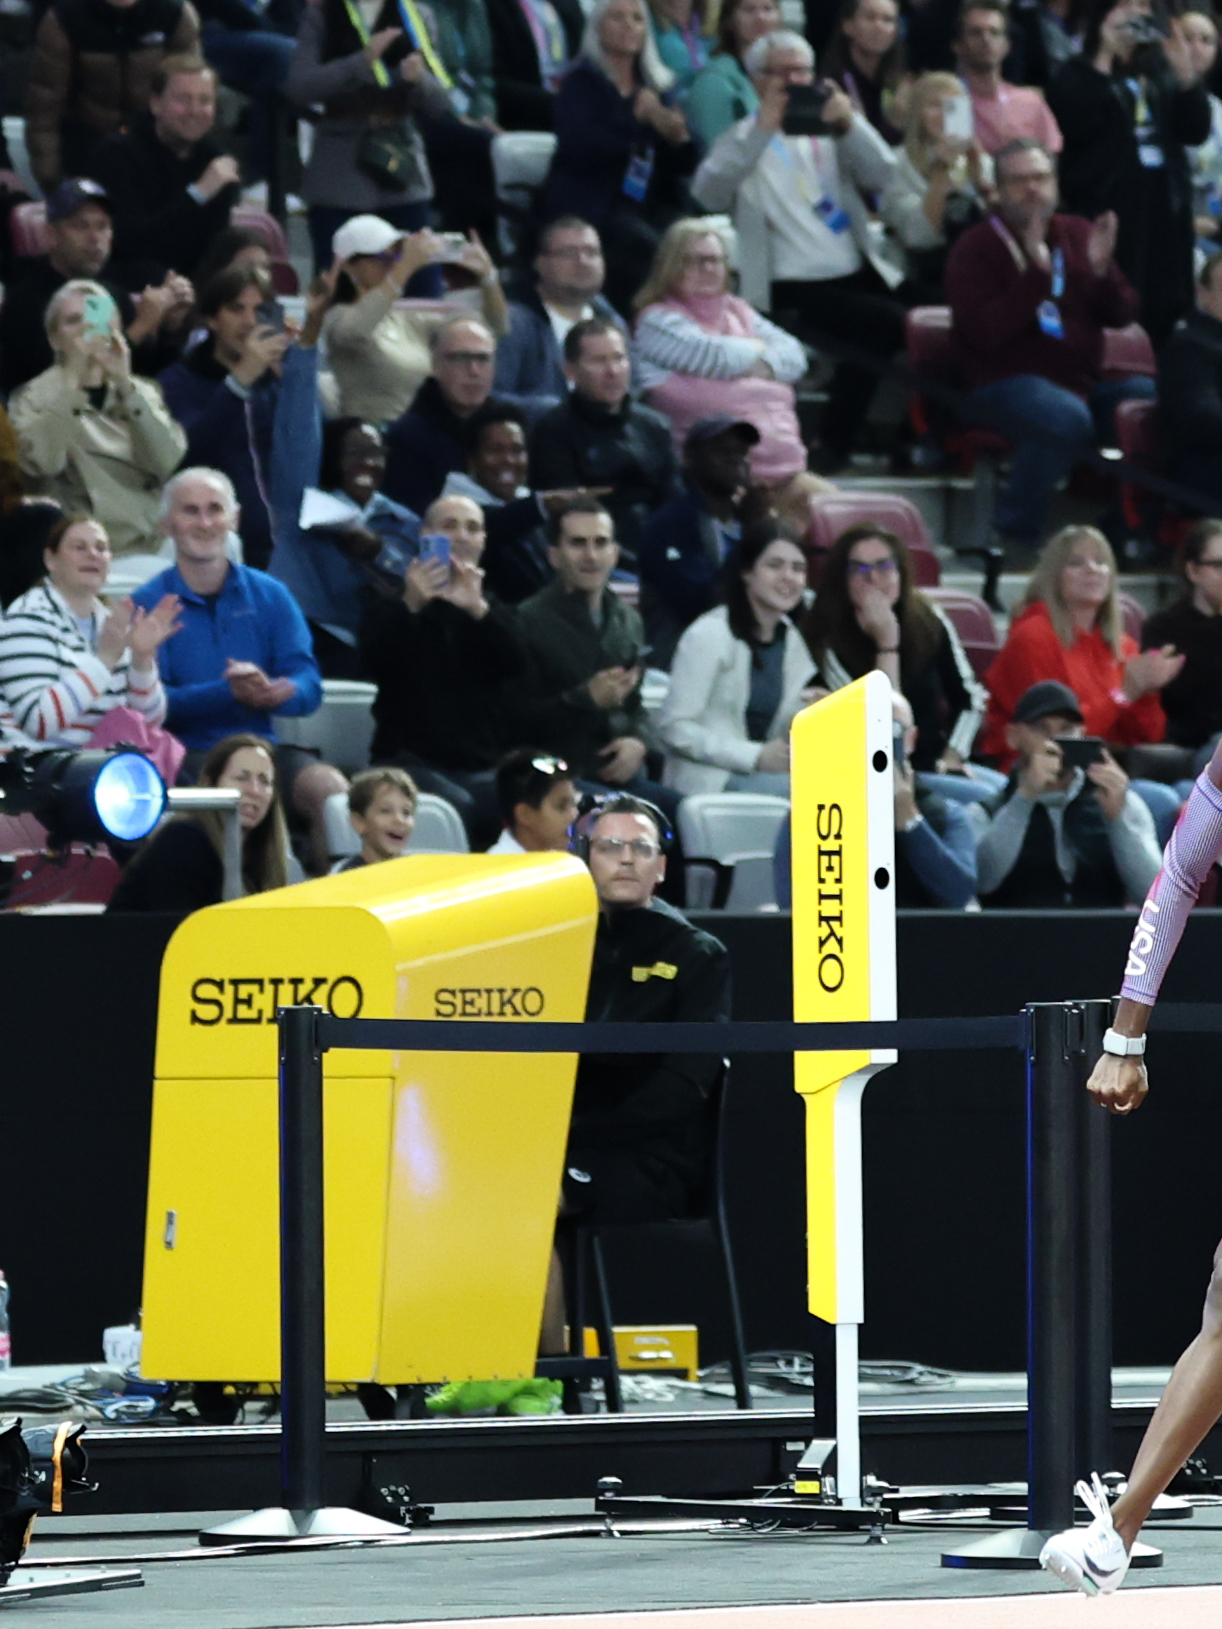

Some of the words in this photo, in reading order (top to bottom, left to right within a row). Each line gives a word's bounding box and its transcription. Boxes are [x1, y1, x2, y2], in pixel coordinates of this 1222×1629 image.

[815, 803, 845, 993] SEIKO
[1124, 899, 1160, 976] USA
[190, 976, 364, 1026] SEIKO
[434, 986, 545, 1018] SEIKO
